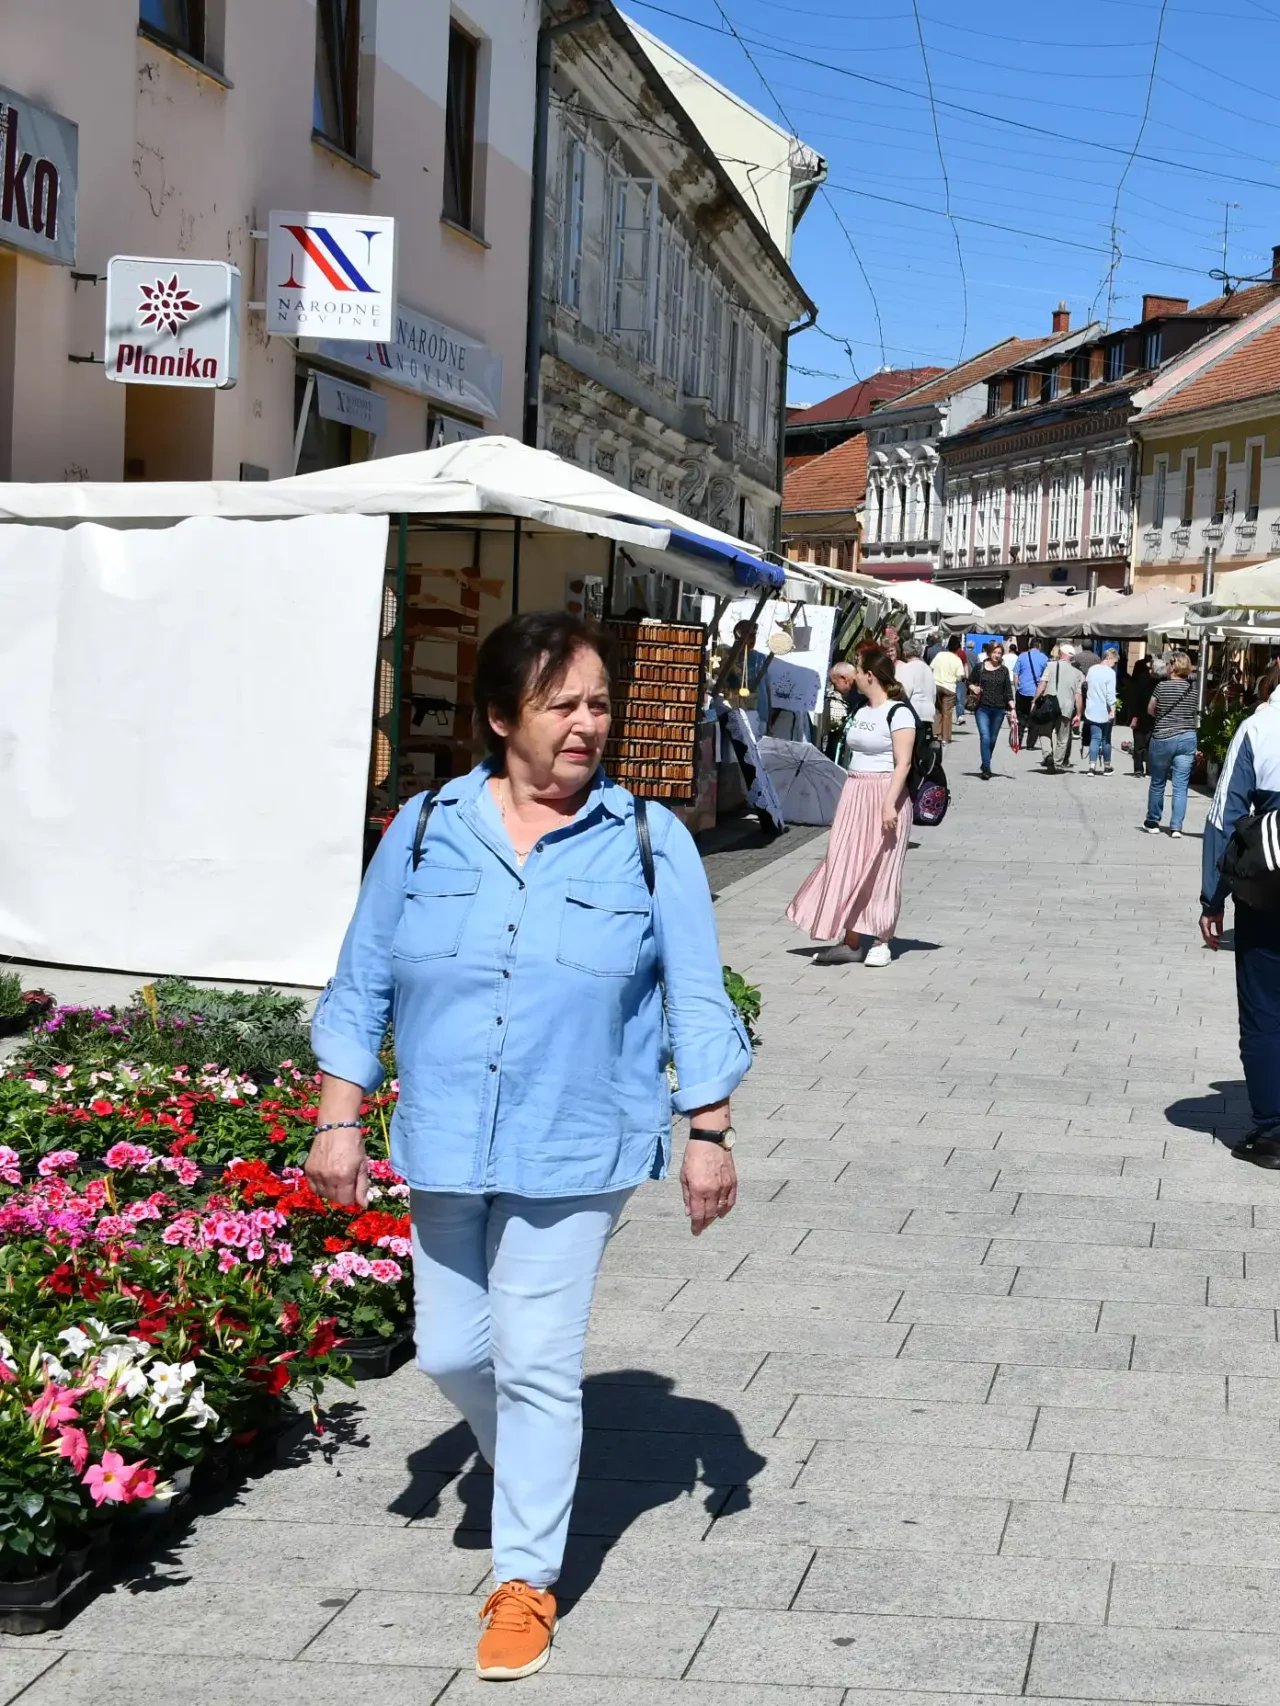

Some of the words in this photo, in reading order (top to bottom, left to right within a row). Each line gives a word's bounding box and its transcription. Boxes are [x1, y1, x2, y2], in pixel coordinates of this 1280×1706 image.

[278, 298, 381, 316] NARODNE
[278, 311, 381, 327] NOVINE
[116, 344, 218, 378] Planika
[397, 318, 466, 371] NARODNE
[396, 352, 465, 396] NOVINE
